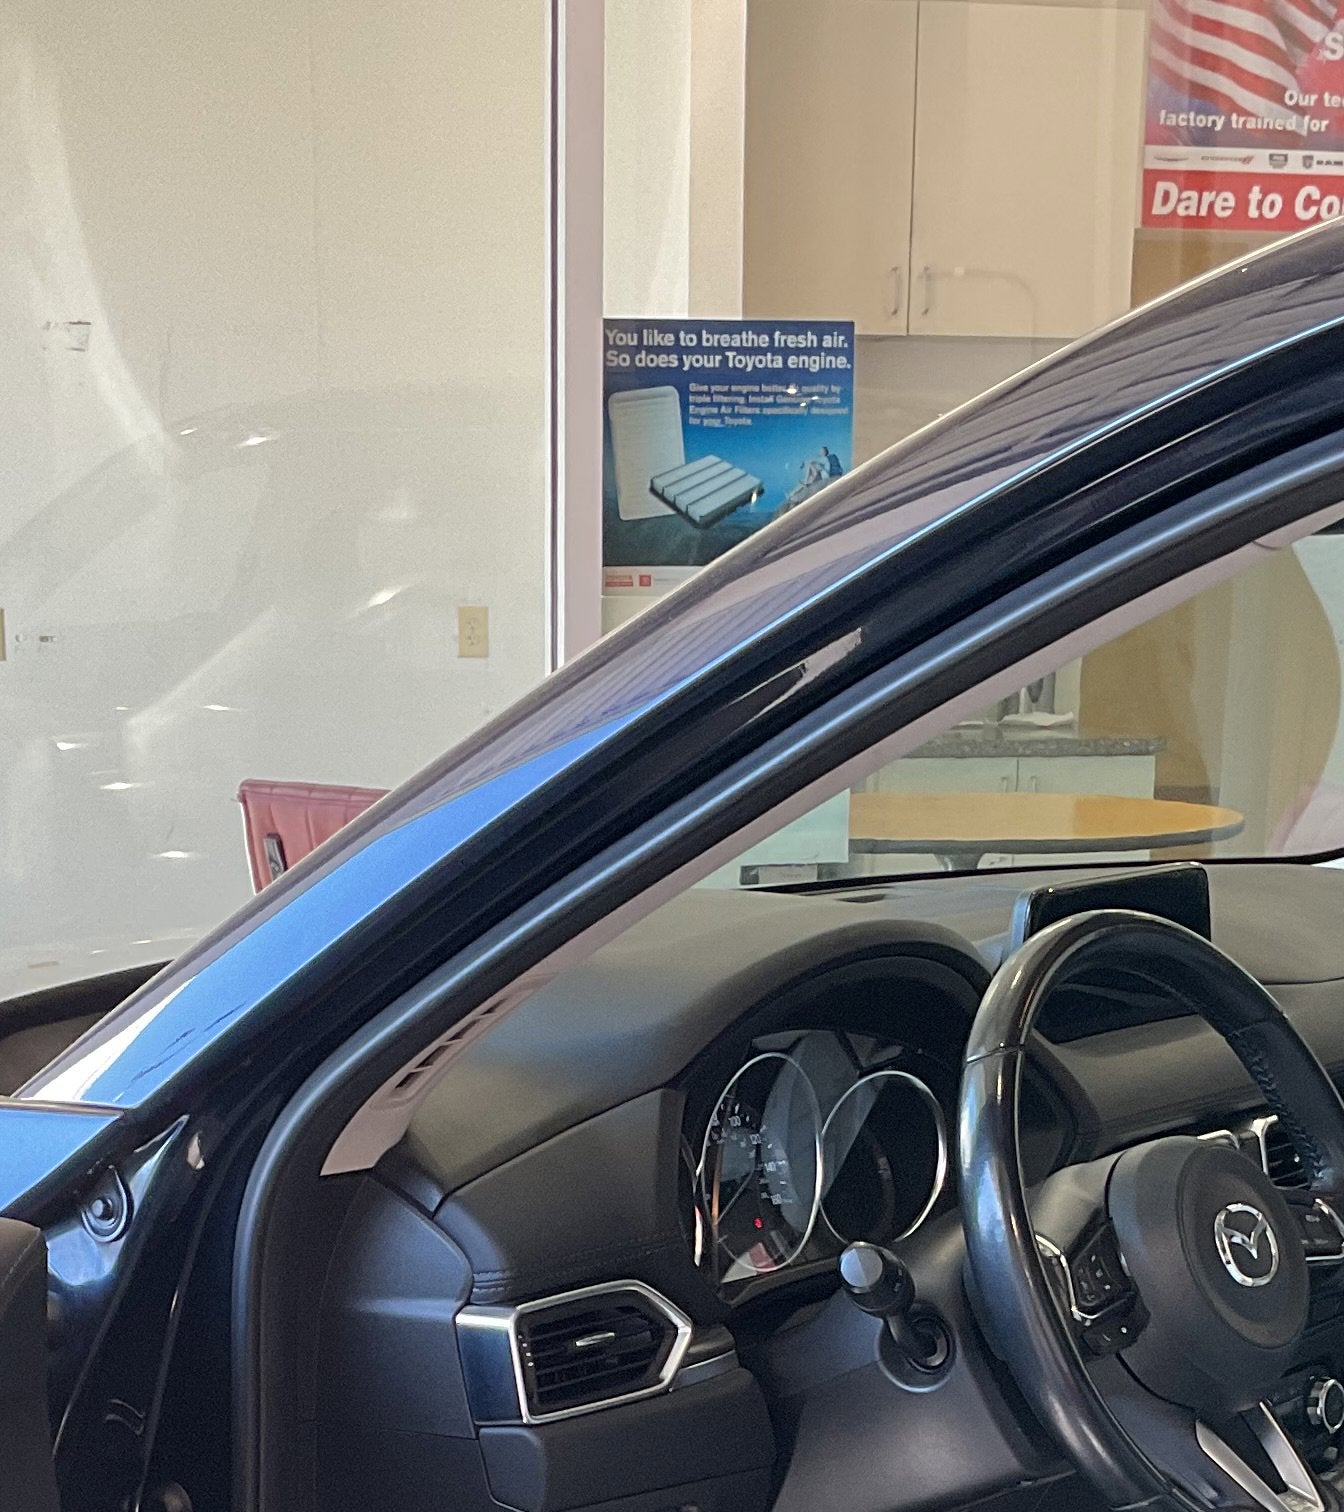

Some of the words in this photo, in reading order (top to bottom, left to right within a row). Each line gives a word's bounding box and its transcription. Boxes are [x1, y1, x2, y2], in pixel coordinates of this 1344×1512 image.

[1284, 90, 1319, 107] Our
[1159, 110, 1225, 131] factory
[1231, 112, 1296, 130] trained
[1303, 115, 1329, 132] for
[1151, 181, 1236, 218] Dare
[1247, 185, 1283, 219] to
[605, 329, 638, 346] You
[642, 329, 675, 346] like
[679, 330, 697, 347] to
[702, 330, 769, 347] breathe
[773, 331, 818, 348] fresh
[822, 332, 849, 348] air.
[606, 350, 631, 367] So
[635, 350, 679, 368] does
[682, 354, 722, 371] your
[725, 351, 783, 372] Toyota
[787, 352, 852, 372] engine.
